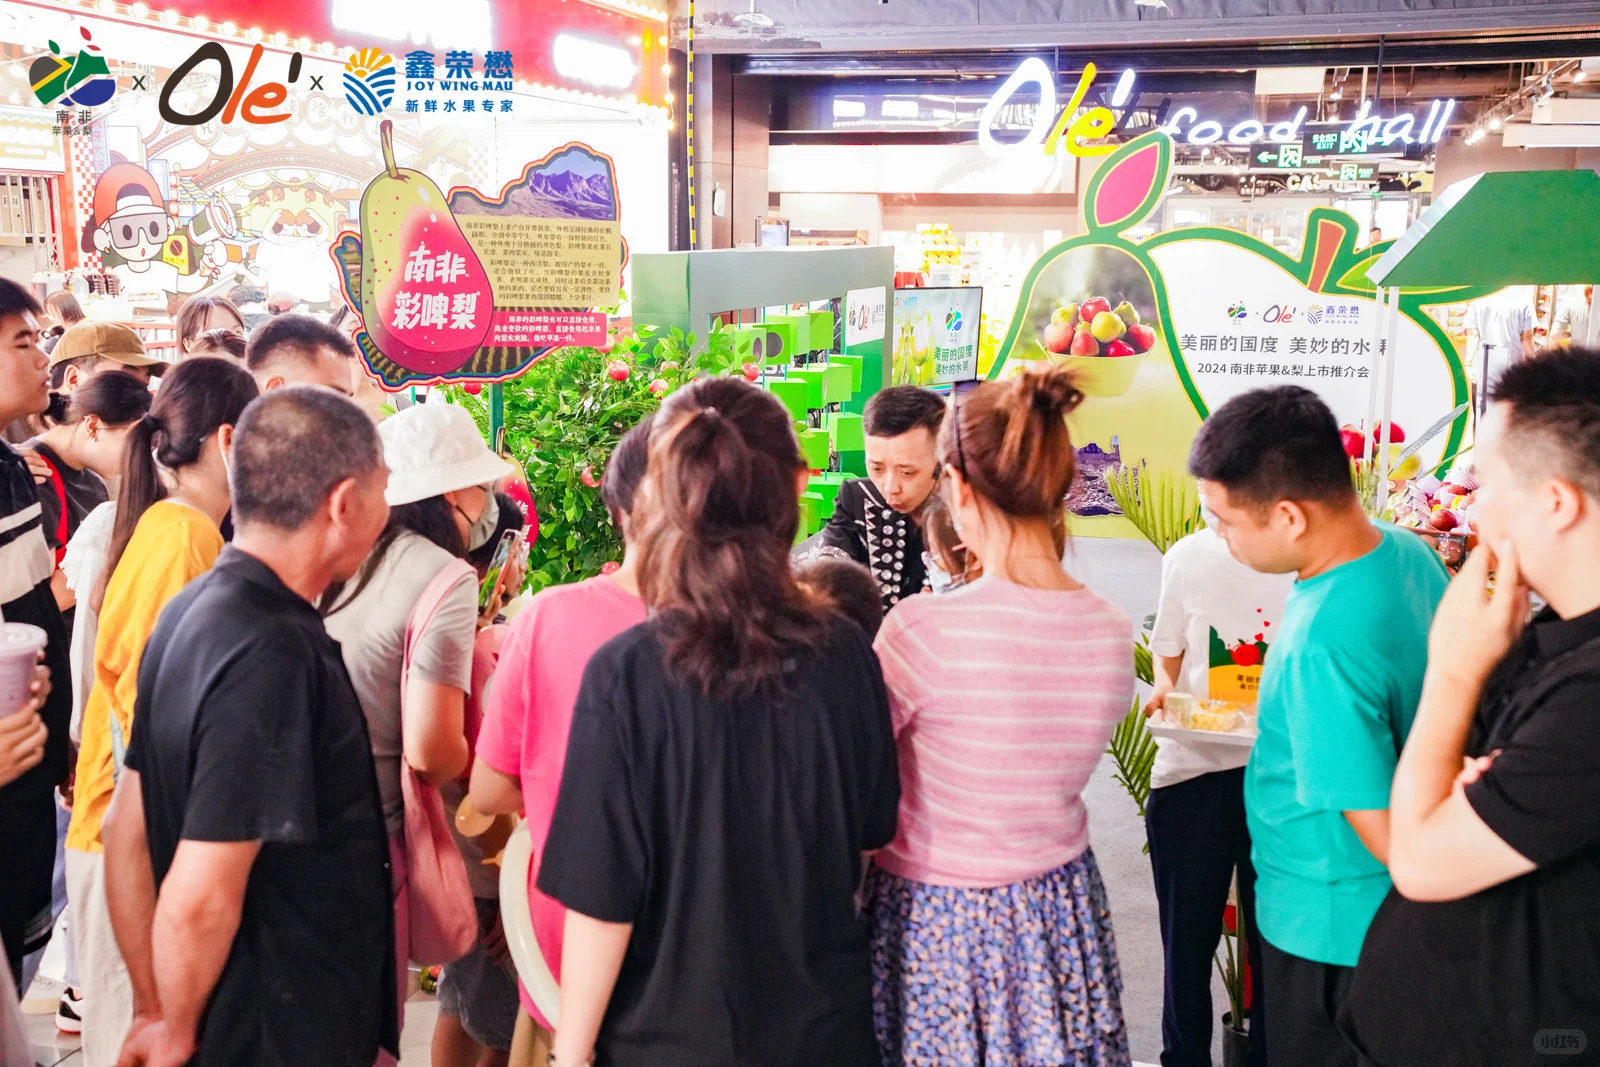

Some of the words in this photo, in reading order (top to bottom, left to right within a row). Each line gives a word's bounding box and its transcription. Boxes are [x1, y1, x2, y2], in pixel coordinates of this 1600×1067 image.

[1162, 105, 1308, 144] food
[1346, 98, 1456, 145] hall
[404, 244, 467, 284] 南非
[391, 292, 477, 330] 彩啤梨
[933, 344, 973, 363] 美丽的国度
[1180, 333, 1278, 354] 美丽的国度
[934, 362, 969, 376] 美妙的水果
[1198, 362, 1227, 374] 2024
[1230, 363, 1370, 378] 南非苹果&梨上市推介会
